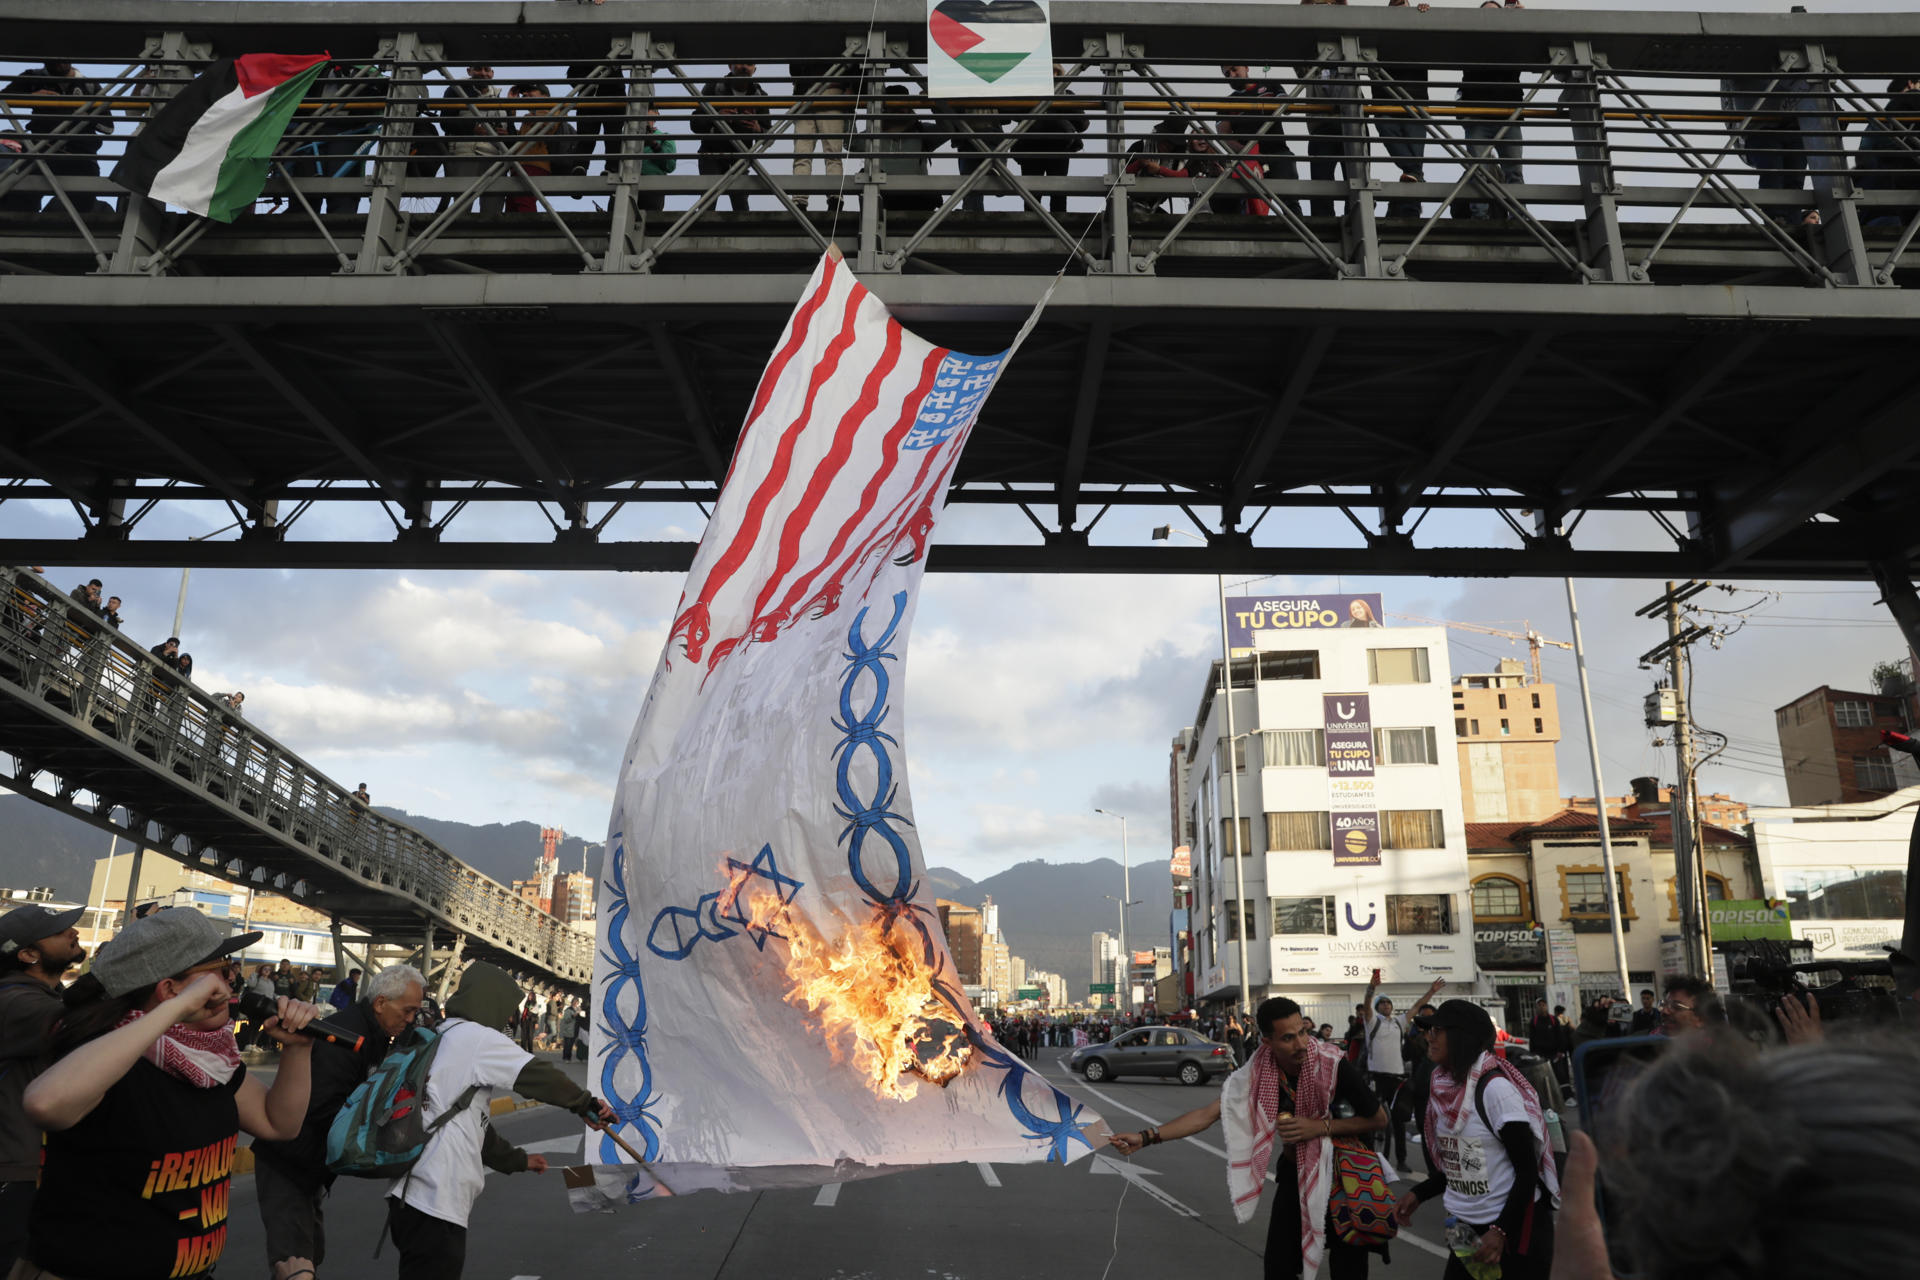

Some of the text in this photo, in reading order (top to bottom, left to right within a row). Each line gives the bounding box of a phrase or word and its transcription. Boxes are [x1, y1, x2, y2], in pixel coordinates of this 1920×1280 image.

[1253, 600, 1321, 612] ASEGURA
[1235, 610, 1338, 629] TU CUPO
[1330, 741, 1368, 749] ASEGURA
[1329, 750, 1371, 759] TU CUPO
[1337, 760, 1373, 771] UNAL
[1335, 817, 1352, 828] 40
[1352, 817, 1376, 826] AÑOS
[1709, 909, 1783, 924] OPISOL
[1474, 930, 1539, 942] COPISOL
[1328, 939, 1398, 951] UNIVÉRSATE
[1343, 965, 1359, 977] 38
